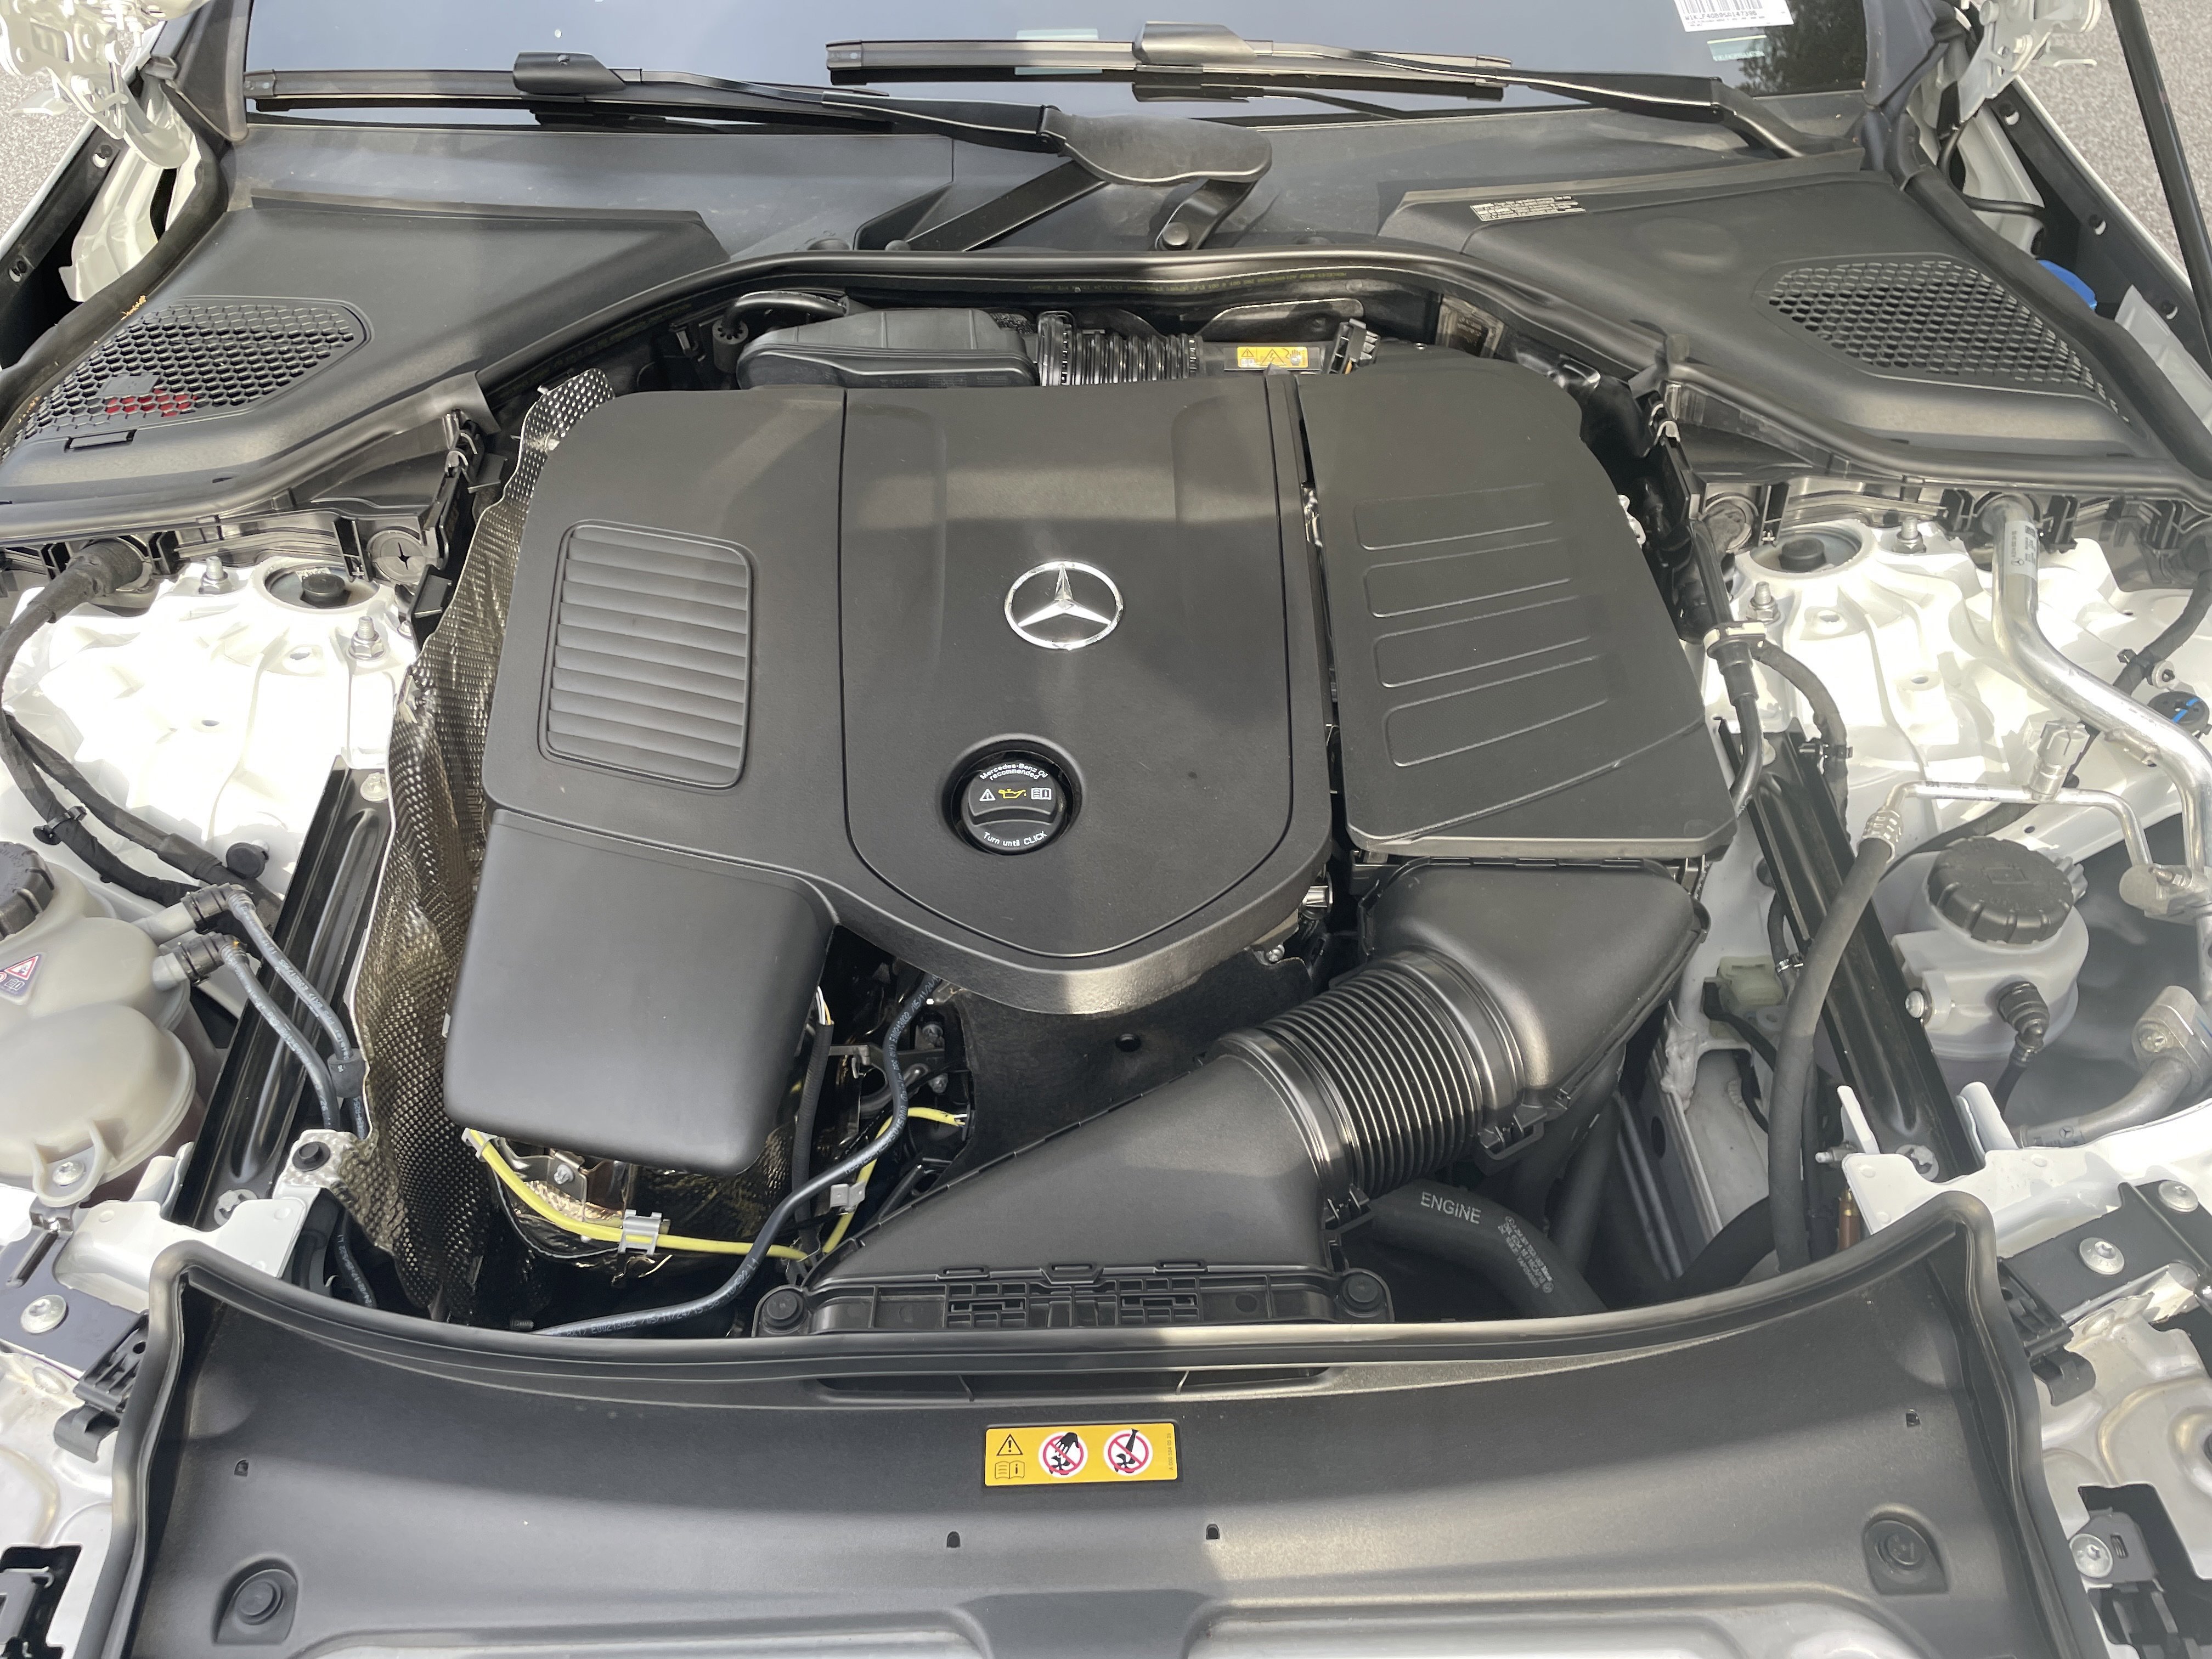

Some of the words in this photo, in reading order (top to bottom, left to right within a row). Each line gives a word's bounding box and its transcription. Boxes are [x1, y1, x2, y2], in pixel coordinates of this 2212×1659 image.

[979, 763, 1037, 780] Mercedes-Benz
[1038, 770, 1048, 778] Oil
[990, 769, 1040, 781] recommended
[983, 832, 1001, 845] Turn
[1002, 839, 1020, 847] until
[1023, 831, 1047, 845] CLICK
[1421, 1191, 1481, 1224] ENGINE
